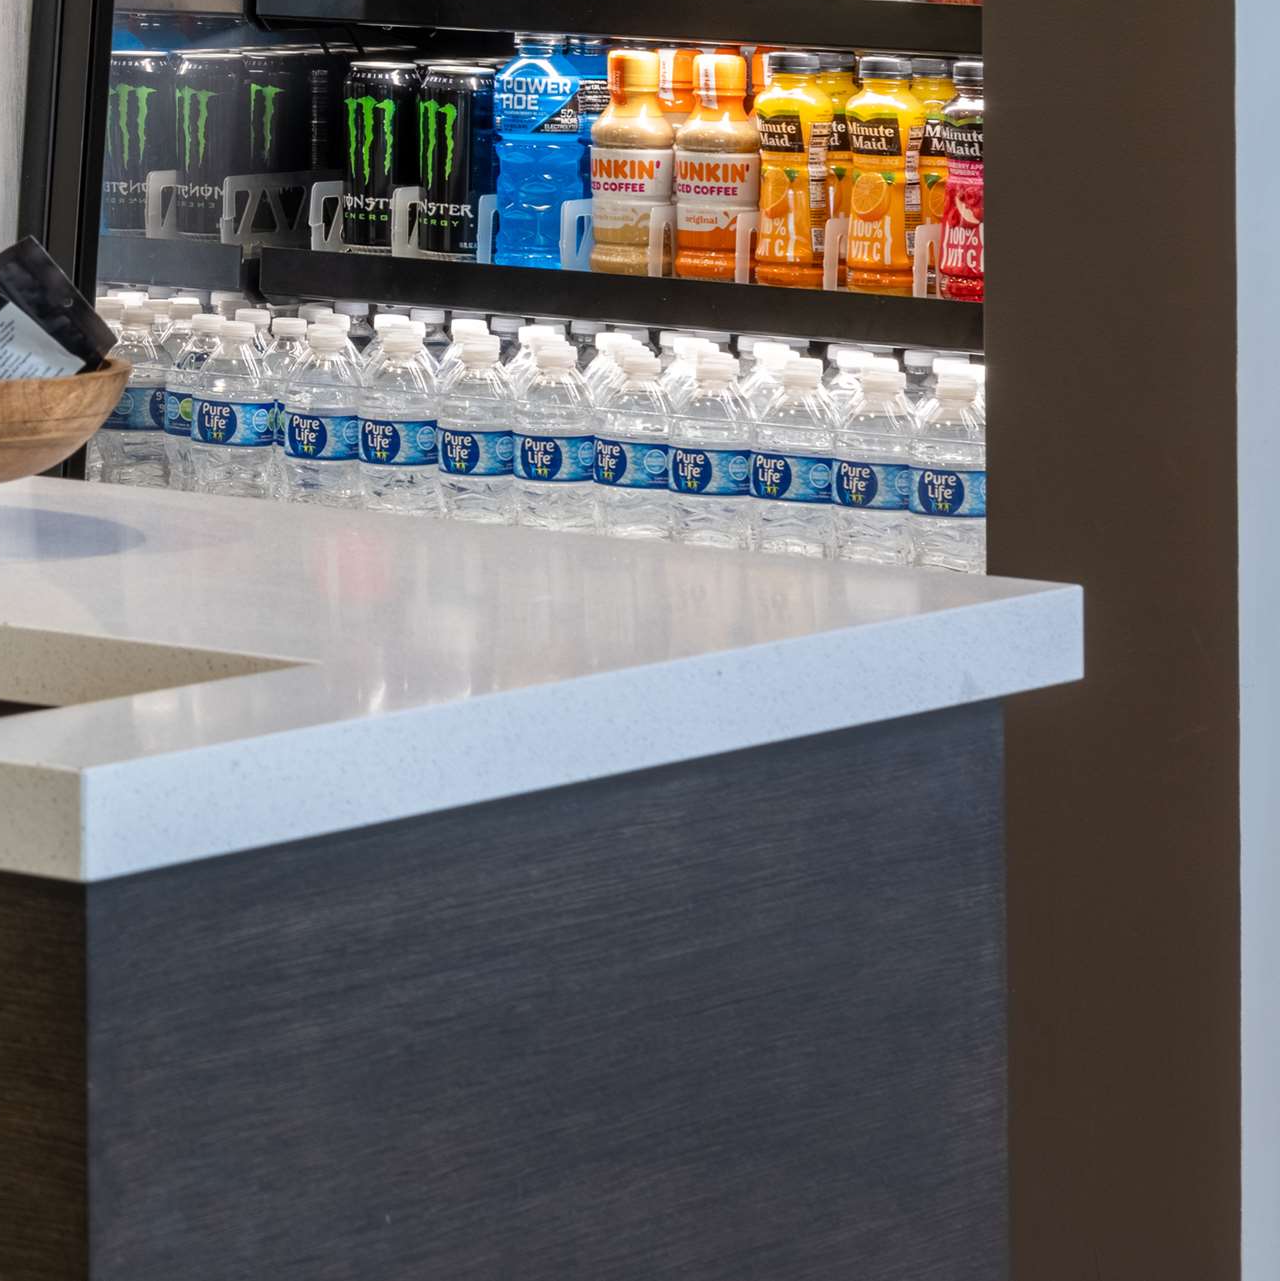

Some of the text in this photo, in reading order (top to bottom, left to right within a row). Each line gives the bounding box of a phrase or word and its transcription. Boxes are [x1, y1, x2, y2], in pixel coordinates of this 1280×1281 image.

[503, 77, 572, 94] POWER
[502, 94, 539, 110] ADE
[853, 138, 888, 151] Maid
[592, 160, 661, 180] UNKIN'
[603, 182, 646, 193] COFFEE
[694, 185, 739, 197] COFFEE
[419, 199, 473, 218] NSTER
[685, 214, 718, 226] original
[851, 241, 881, 263] VIT C
[948, 248, 977, 268] VIT C
[202, 401, 231, 419] Pure
[204, 414, 227, 431] Life
[292, 414, 321, 432] Pure
[365, 420, 393, 439] Pure
[295, 428, 317, 444] Life
[368, 434, 391, 451] Life
